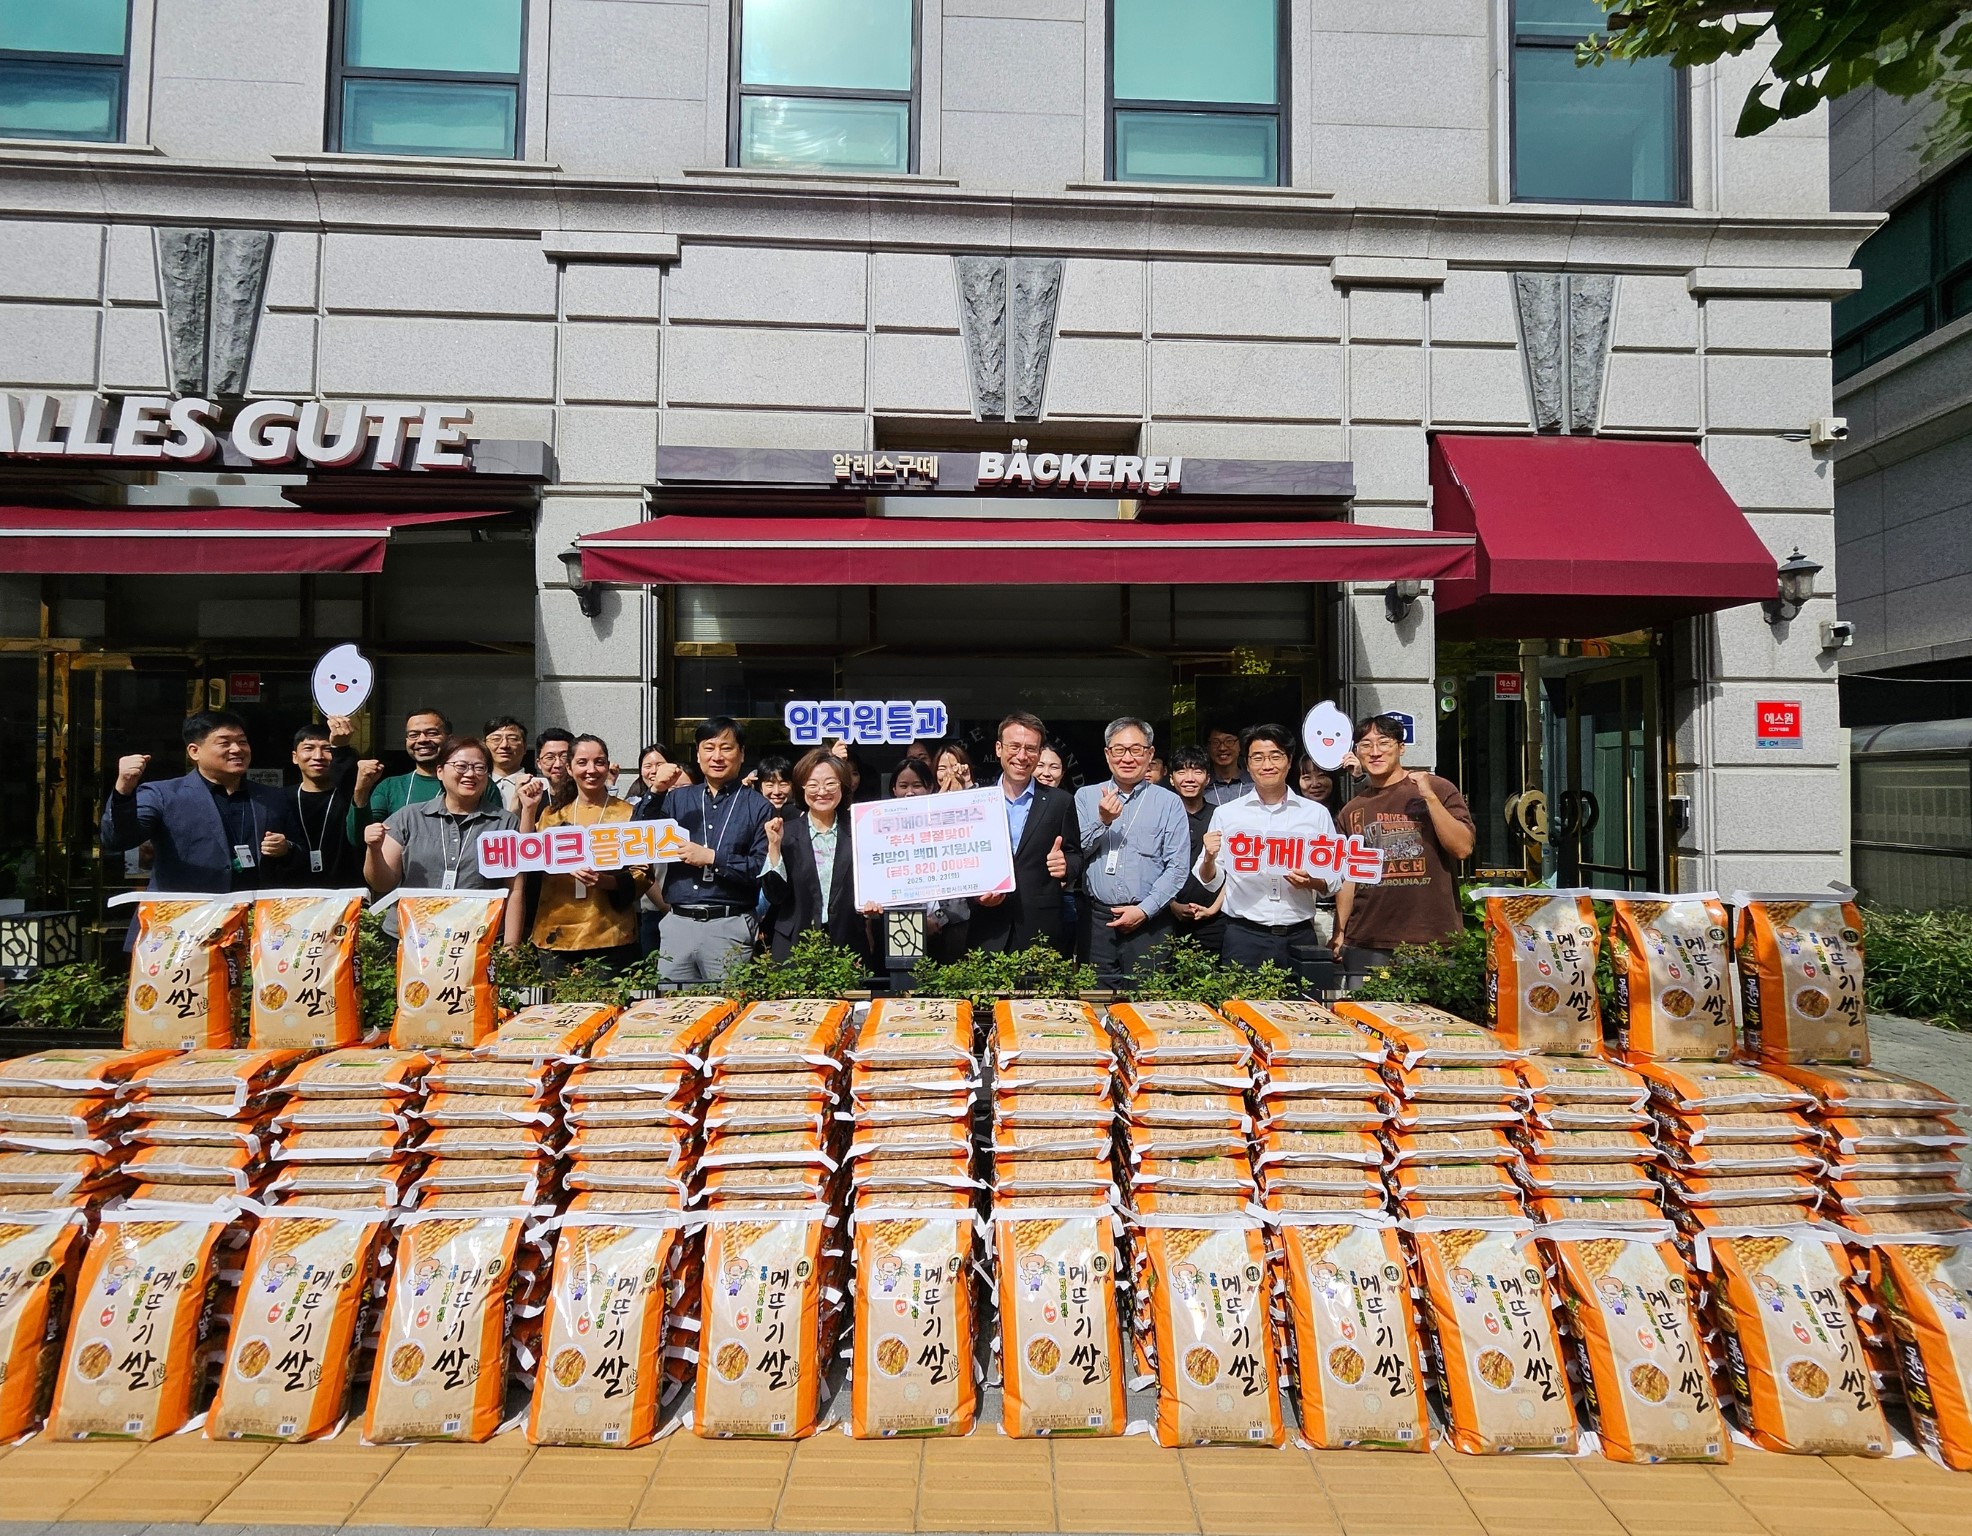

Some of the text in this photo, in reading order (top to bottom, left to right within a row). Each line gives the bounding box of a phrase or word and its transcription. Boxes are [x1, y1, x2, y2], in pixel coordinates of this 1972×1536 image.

[232, 399, 474, 470] GUTE
[832, 453, 939, 479] 알레스구떼
[977, 438, 1182, 488] BÄCKEREI
[790, 705, 946, 740] 임직원들과
[1764, 712, 1794, 725] 에스원
[872, 840, 992, 866] 희망의 백미 지원사업
